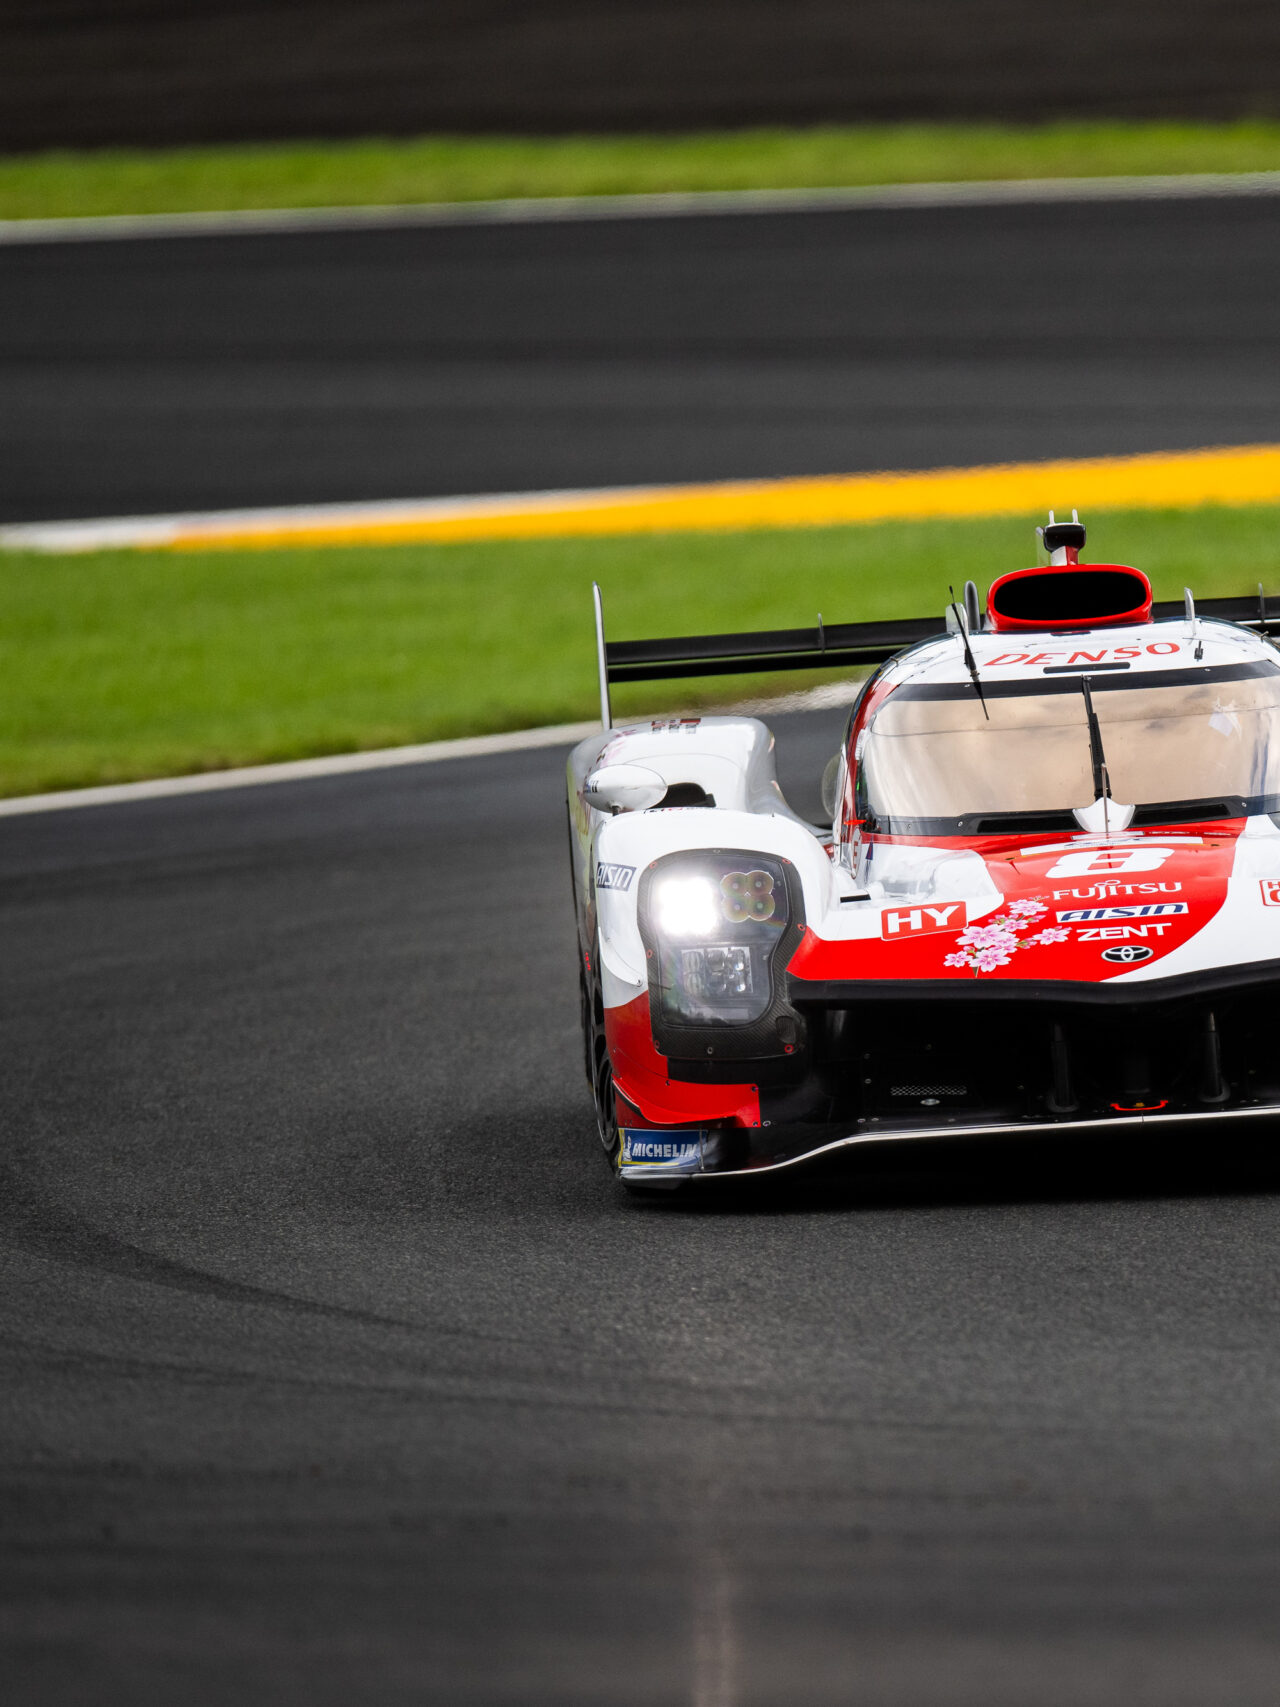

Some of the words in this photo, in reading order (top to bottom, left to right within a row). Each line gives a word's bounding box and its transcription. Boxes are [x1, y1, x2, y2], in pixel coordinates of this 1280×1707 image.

[982, 642, 1180, 666] DENSO
[1045, 847, 1175, 879] 8
[598, 864, 633, 888] AISIN
[1053, 879, 1182, 901] FUJITSU
[887, 905, 961, 934] HY
[1060, 903, 1184, 922] AISIN
[1076, 922, 1172, 942] ZENT
[632, 1143, 697, 1158] MICHELIN
